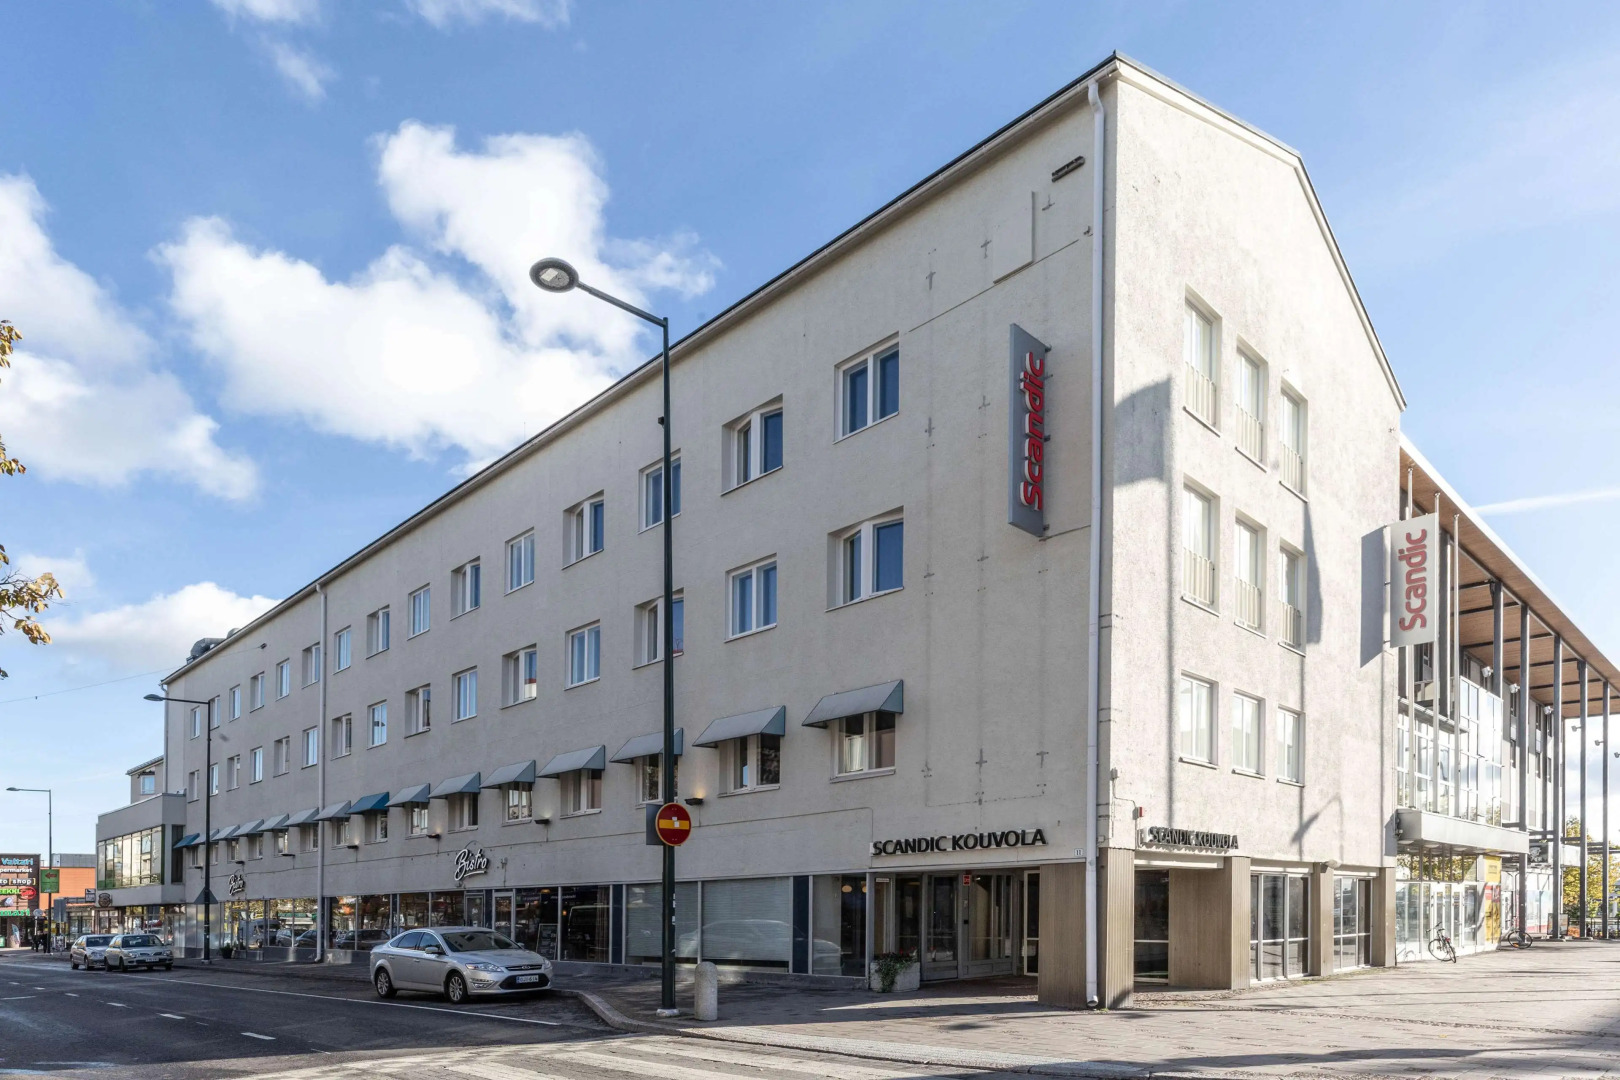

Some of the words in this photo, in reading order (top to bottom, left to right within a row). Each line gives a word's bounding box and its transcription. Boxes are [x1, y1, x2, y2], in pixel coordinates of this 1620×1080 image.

[1019, 352, 1044, 511] Scandic
[1398, 528, 1428, 632] Scandic
[453, 848, 489, 881] Bistro
[873, 836, 948, 856] SCANDIC
[951, 828, 1048, 851] KOUVOLA
